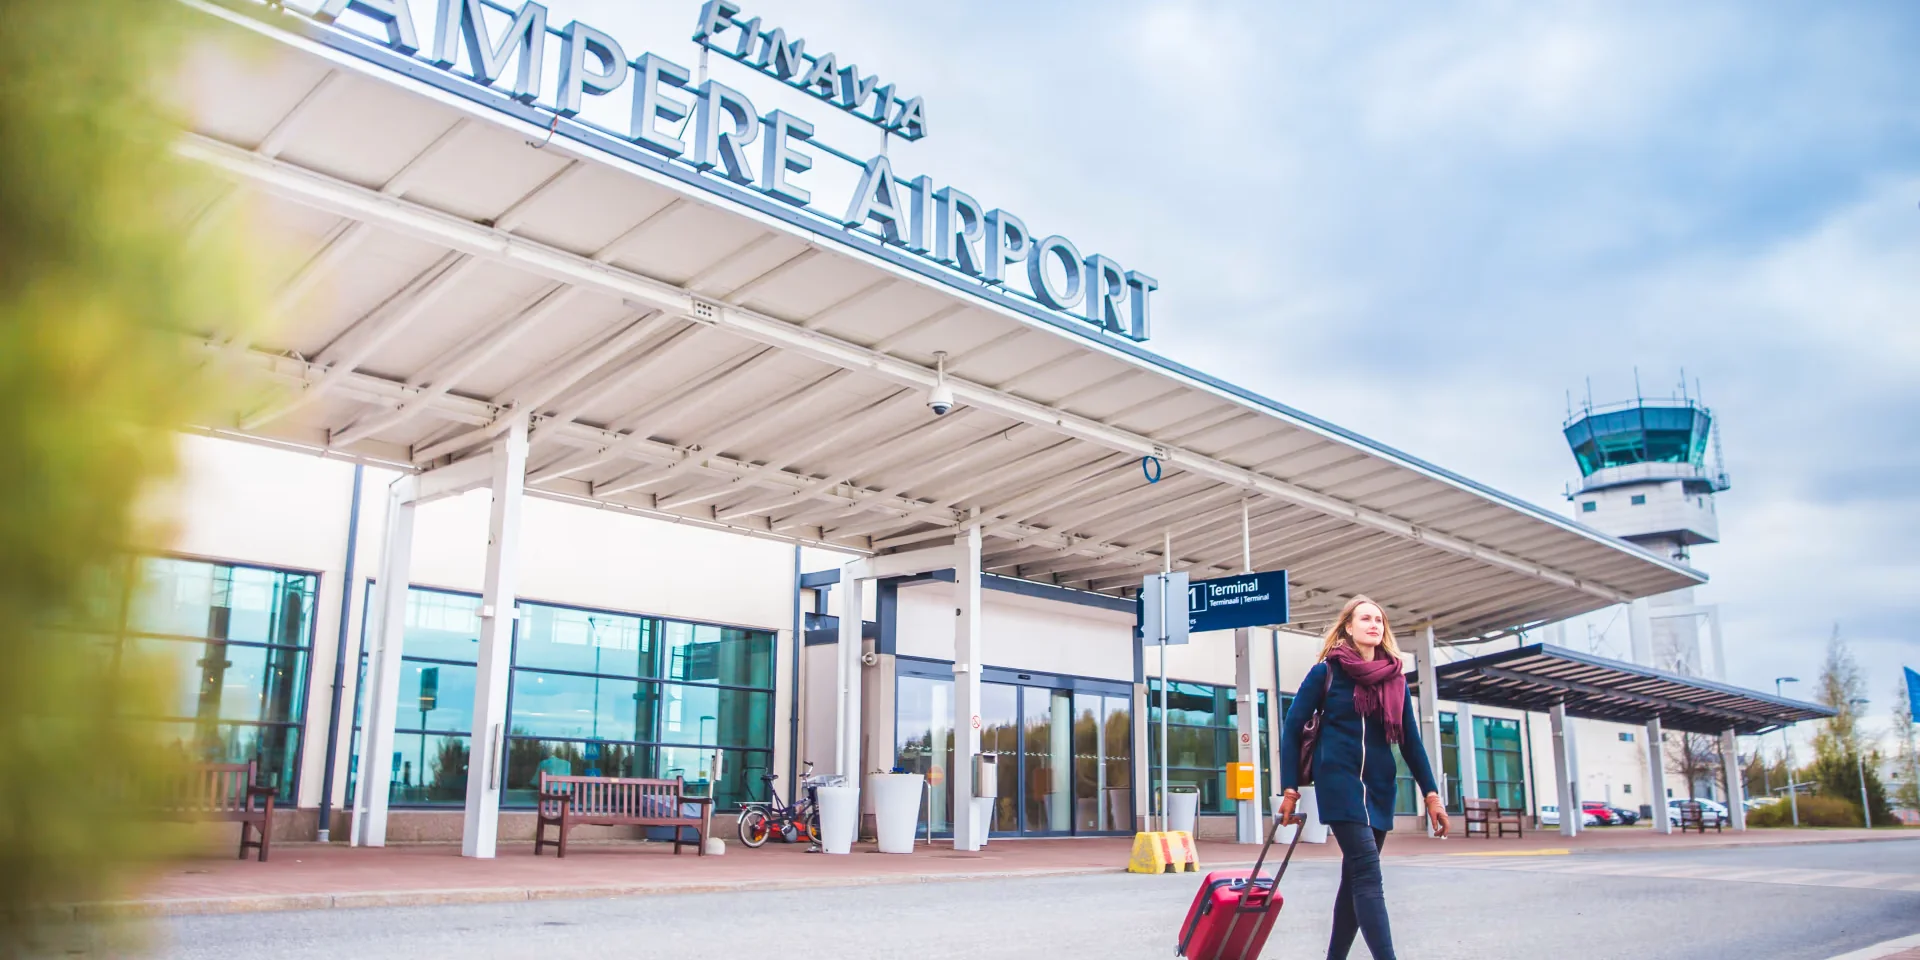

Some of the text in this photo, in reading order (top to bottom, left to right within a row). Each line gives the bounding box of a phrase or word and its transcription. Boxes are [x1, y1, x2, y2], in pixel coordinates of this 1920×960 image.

[693, 0, 928, 142] FINAVIA
[843, 154, 1158, 341] AIRPORT
[1209, 578, 1259, 597] Terminal
[1209, 597, 1240, 607] Terminaali
[1243, 593, 1270, 603] Terminal
